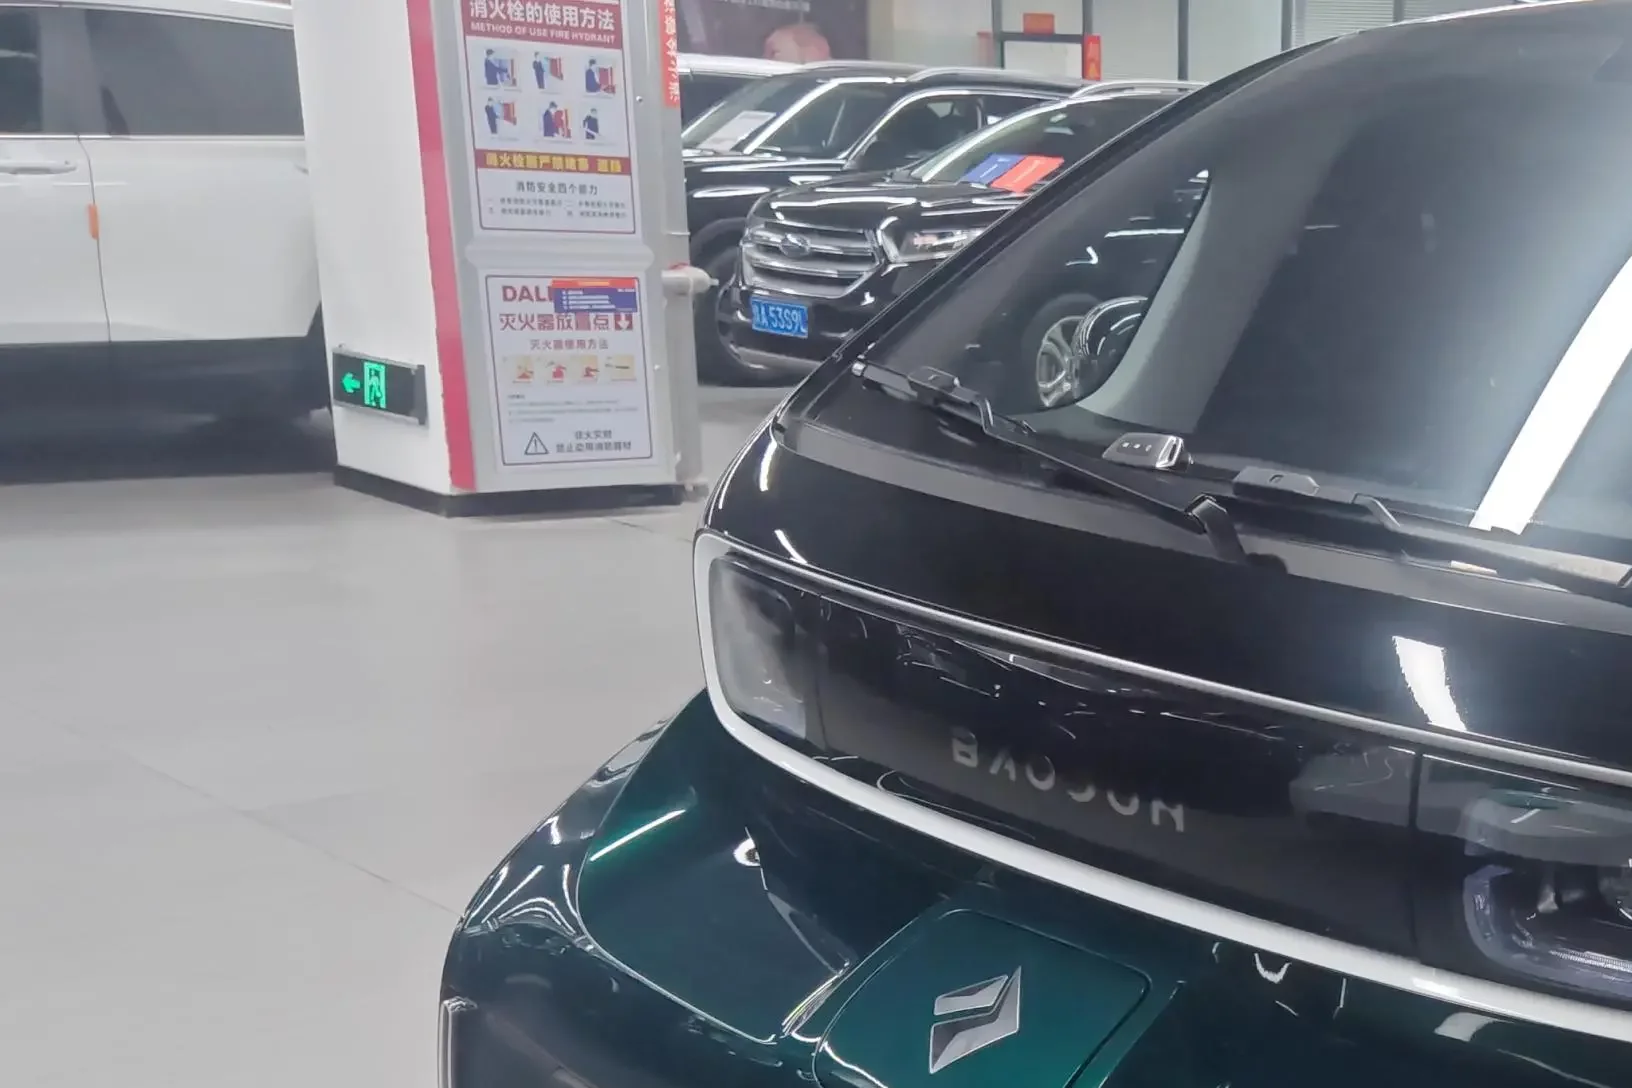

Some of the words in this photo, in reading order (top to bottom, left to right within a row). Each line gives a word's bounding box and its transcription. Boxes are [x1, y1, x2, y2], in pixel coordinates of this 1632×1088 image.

[470, 0, 615, 31] 消火栓的使用方法
[471, 22, 512, 35] METHOD
[514, 25, 527, 35] OF
[530, 27, 548, 37] USE
[550, 29, 570, 40] FIRE
[571, 31, 616, 44] HYDRANT
